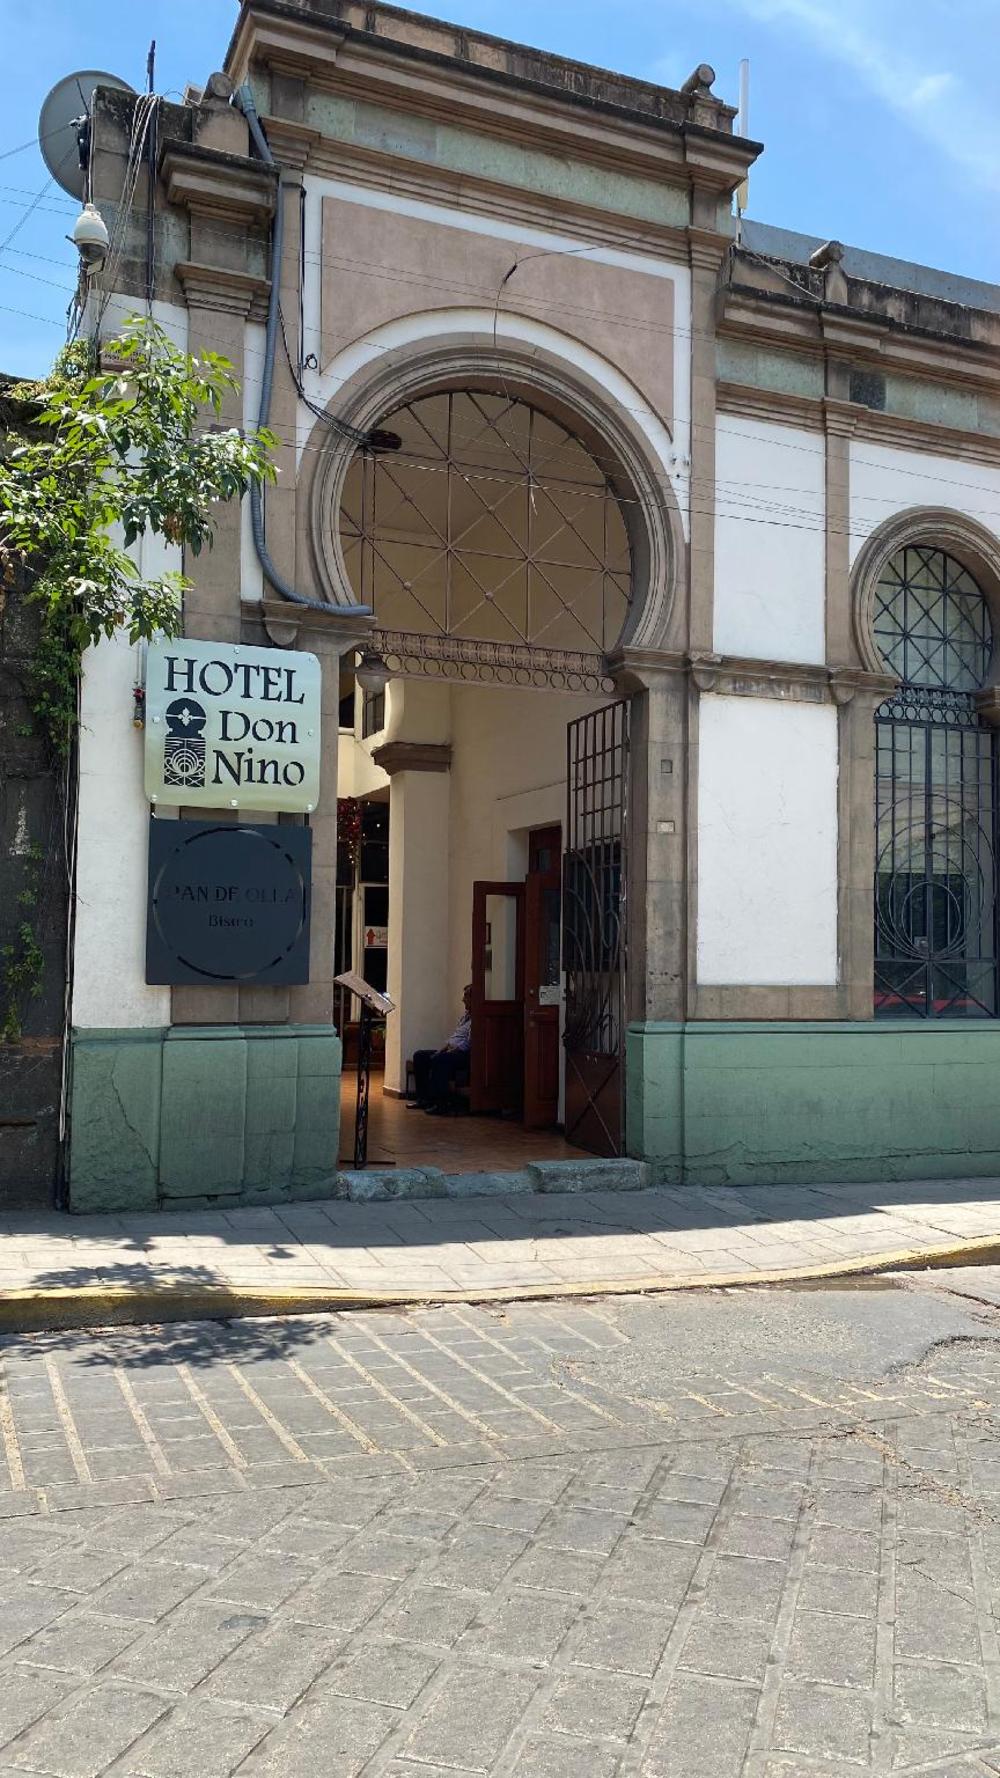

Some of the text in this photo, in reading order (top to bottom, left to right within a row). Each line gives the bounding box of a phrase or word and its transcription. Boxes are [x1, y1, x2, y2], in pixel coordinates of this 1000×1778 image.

[164, 656, 305, 704] HOTEL
[218, 710, 299, 744] Don
[211, 747, 305, 786] Nino
